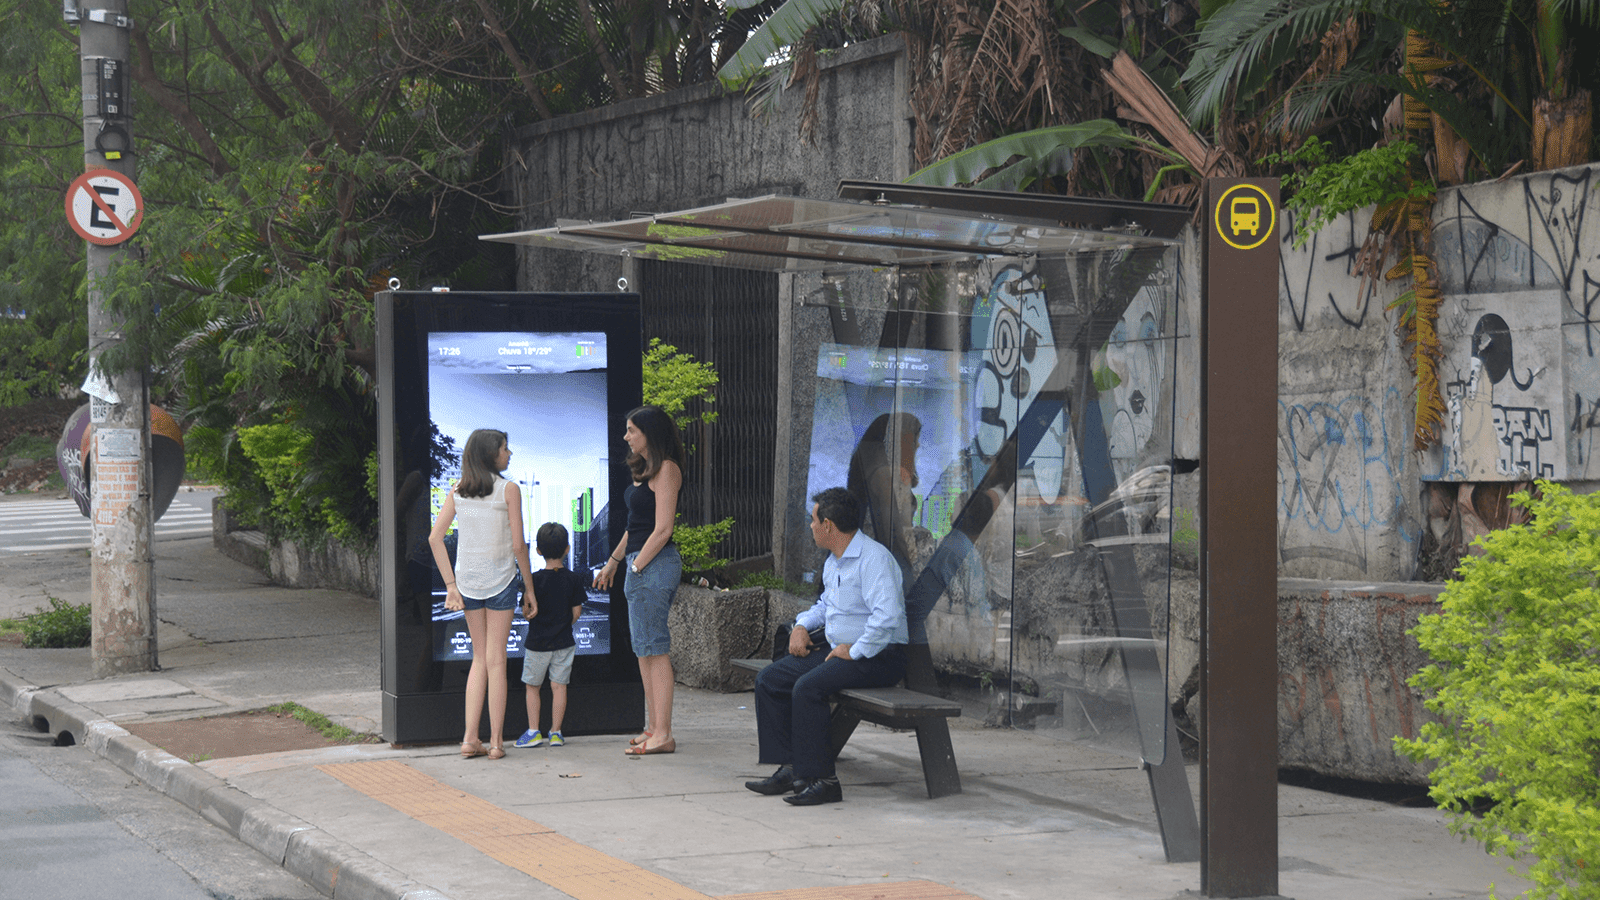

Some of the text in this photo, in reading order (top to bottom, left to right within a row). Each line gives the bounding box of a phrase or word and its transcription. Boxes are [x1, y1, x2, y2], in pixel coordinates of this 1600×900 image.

[91, 185, 119, 230] E
[438, 347, 461, 355] 17:26
[498, 347, 521, 355] Chuva
